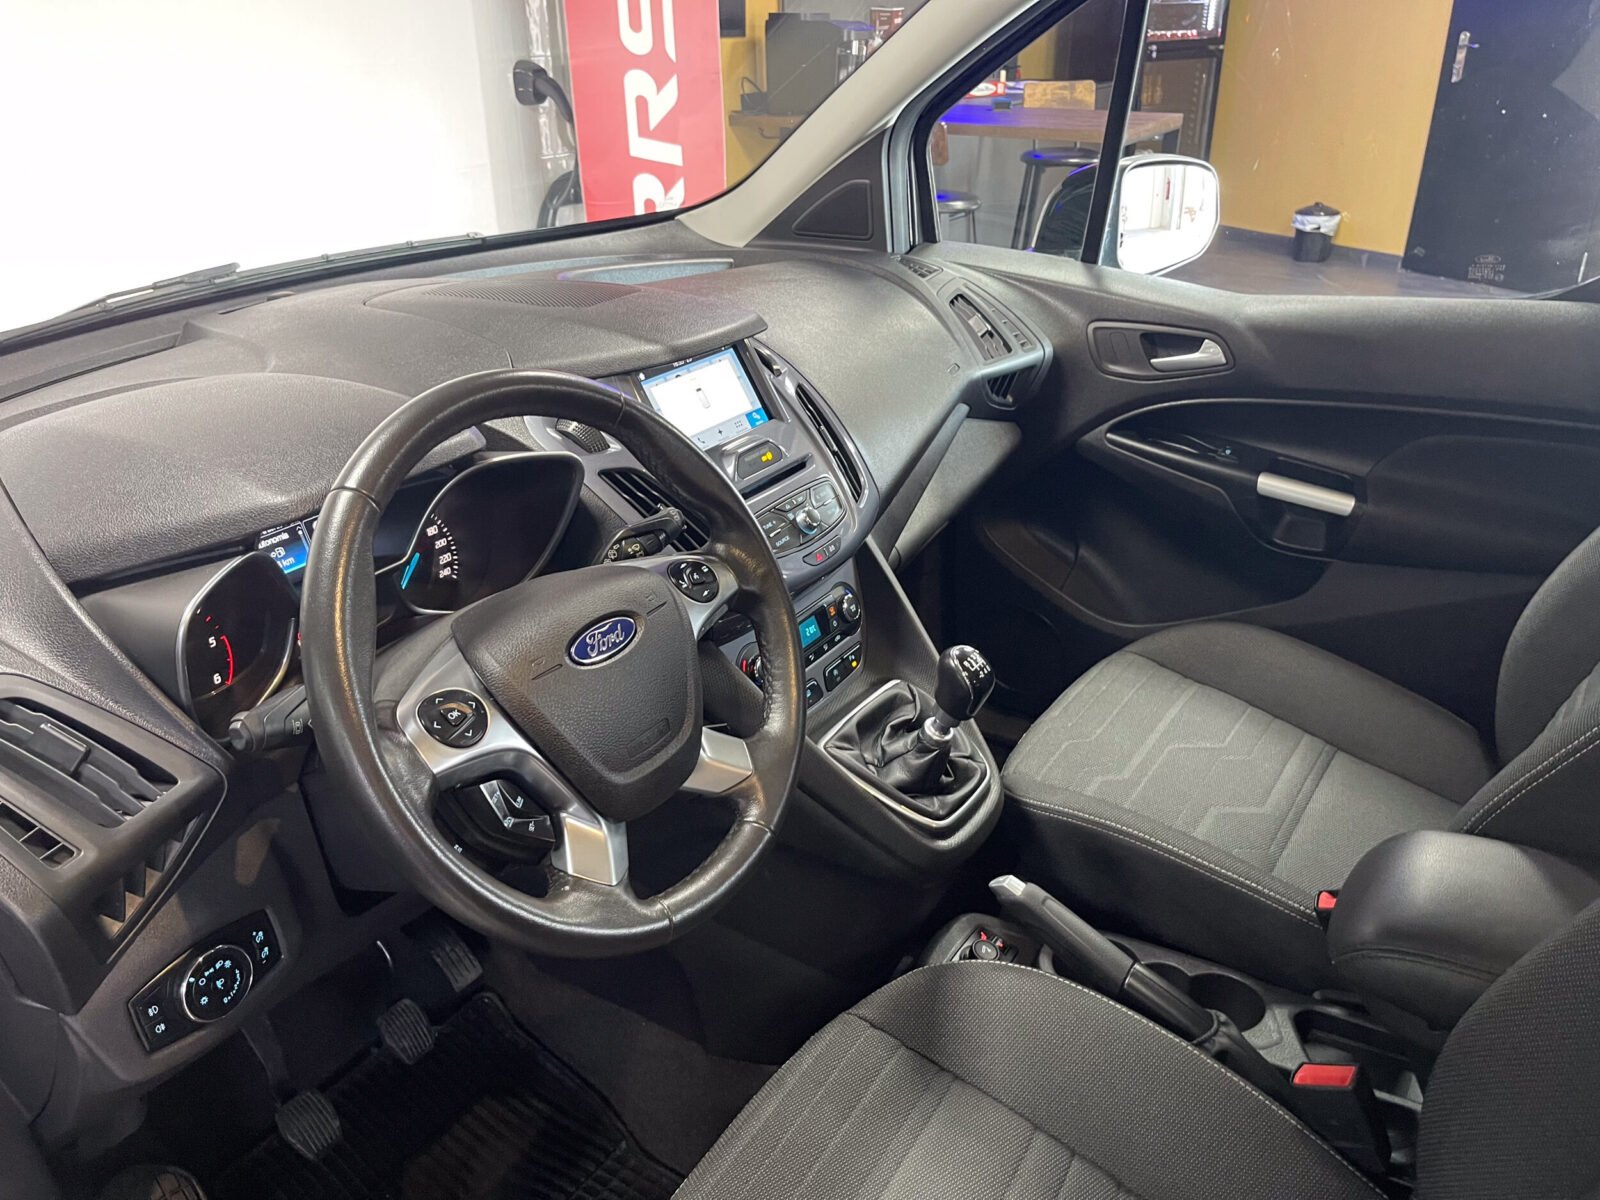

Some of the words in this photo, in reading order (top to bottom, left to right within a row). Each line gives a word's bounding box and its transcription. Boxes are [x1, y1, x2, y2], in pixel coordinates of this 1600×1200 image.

[426, 524, 438, 536] 180
[258, 532, 290, 549] utonomía
[434, 537, 447, 549] 200
[775, 535, 790, 547] SOURCE
[438, 551, 451, 564] 220
[438, 566, 451, 578] 240
[208, 636, 217, 648] 5
[586, 621, 624, 657] Ford
[213, 673, 222, 684] 6
[447, 709, 462, 721] OK
